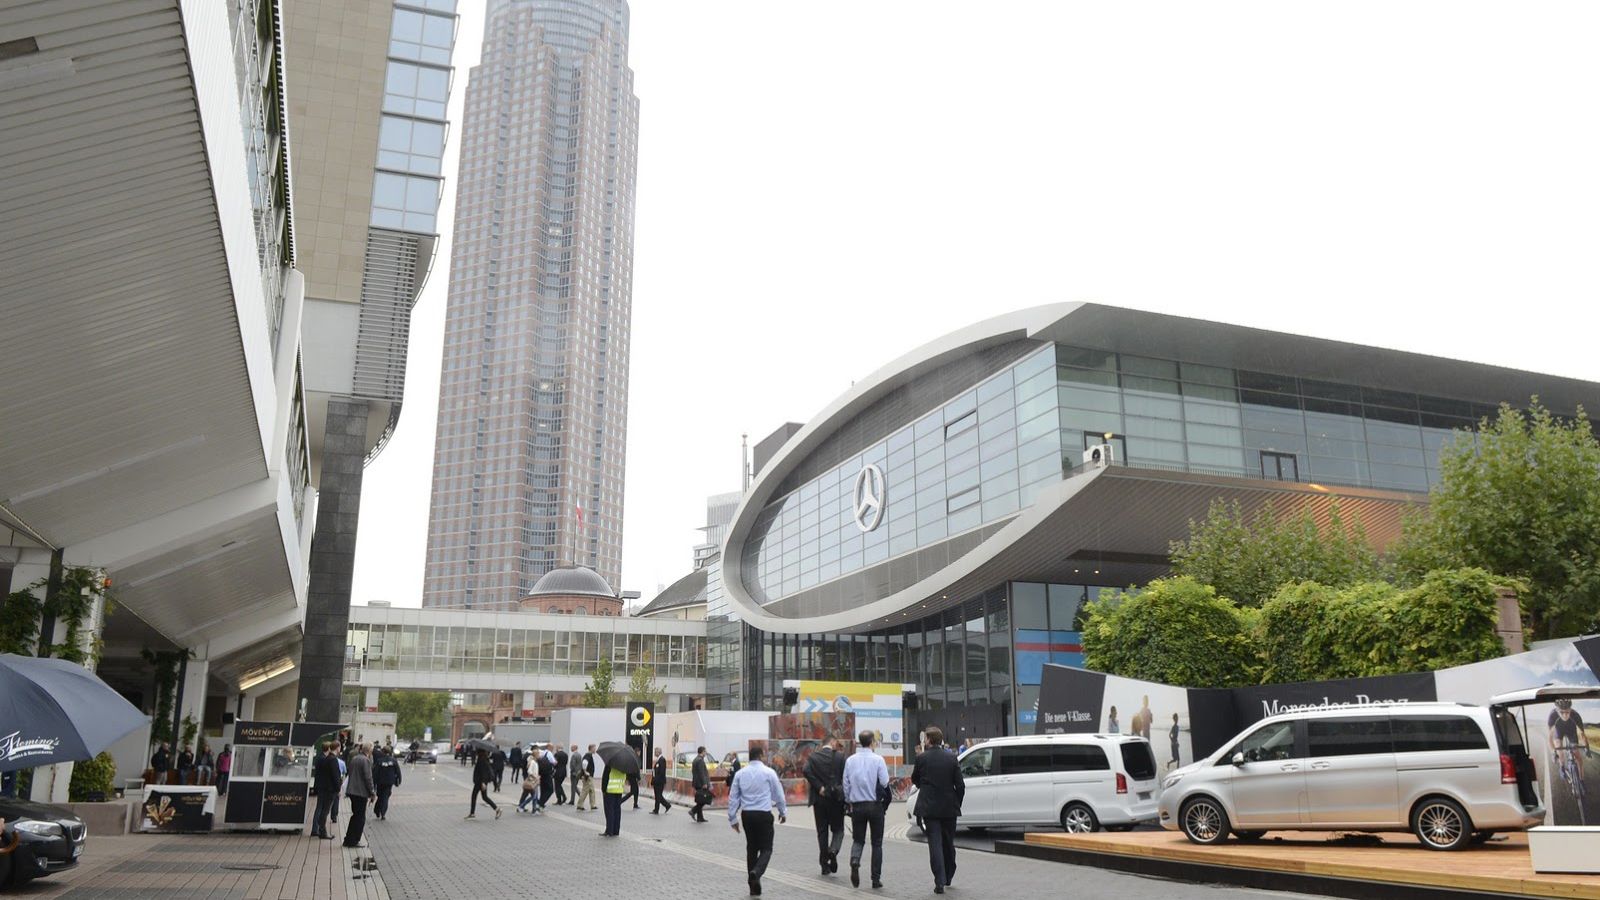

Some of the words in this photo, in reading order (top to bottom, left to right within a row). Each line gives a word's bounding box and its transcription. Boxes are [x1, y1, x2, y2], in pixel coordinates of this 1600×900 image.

[1044, 712, 1054, 723] Die
[1054, 713, 1067, 722] neue
[1067, 710, 1092, 721] V-Klasse.
[241, 727, 284, 737] MÖVENPICK
[630, 728, 650, 736] smart
[0, 730, 60, 760] Fleming's
